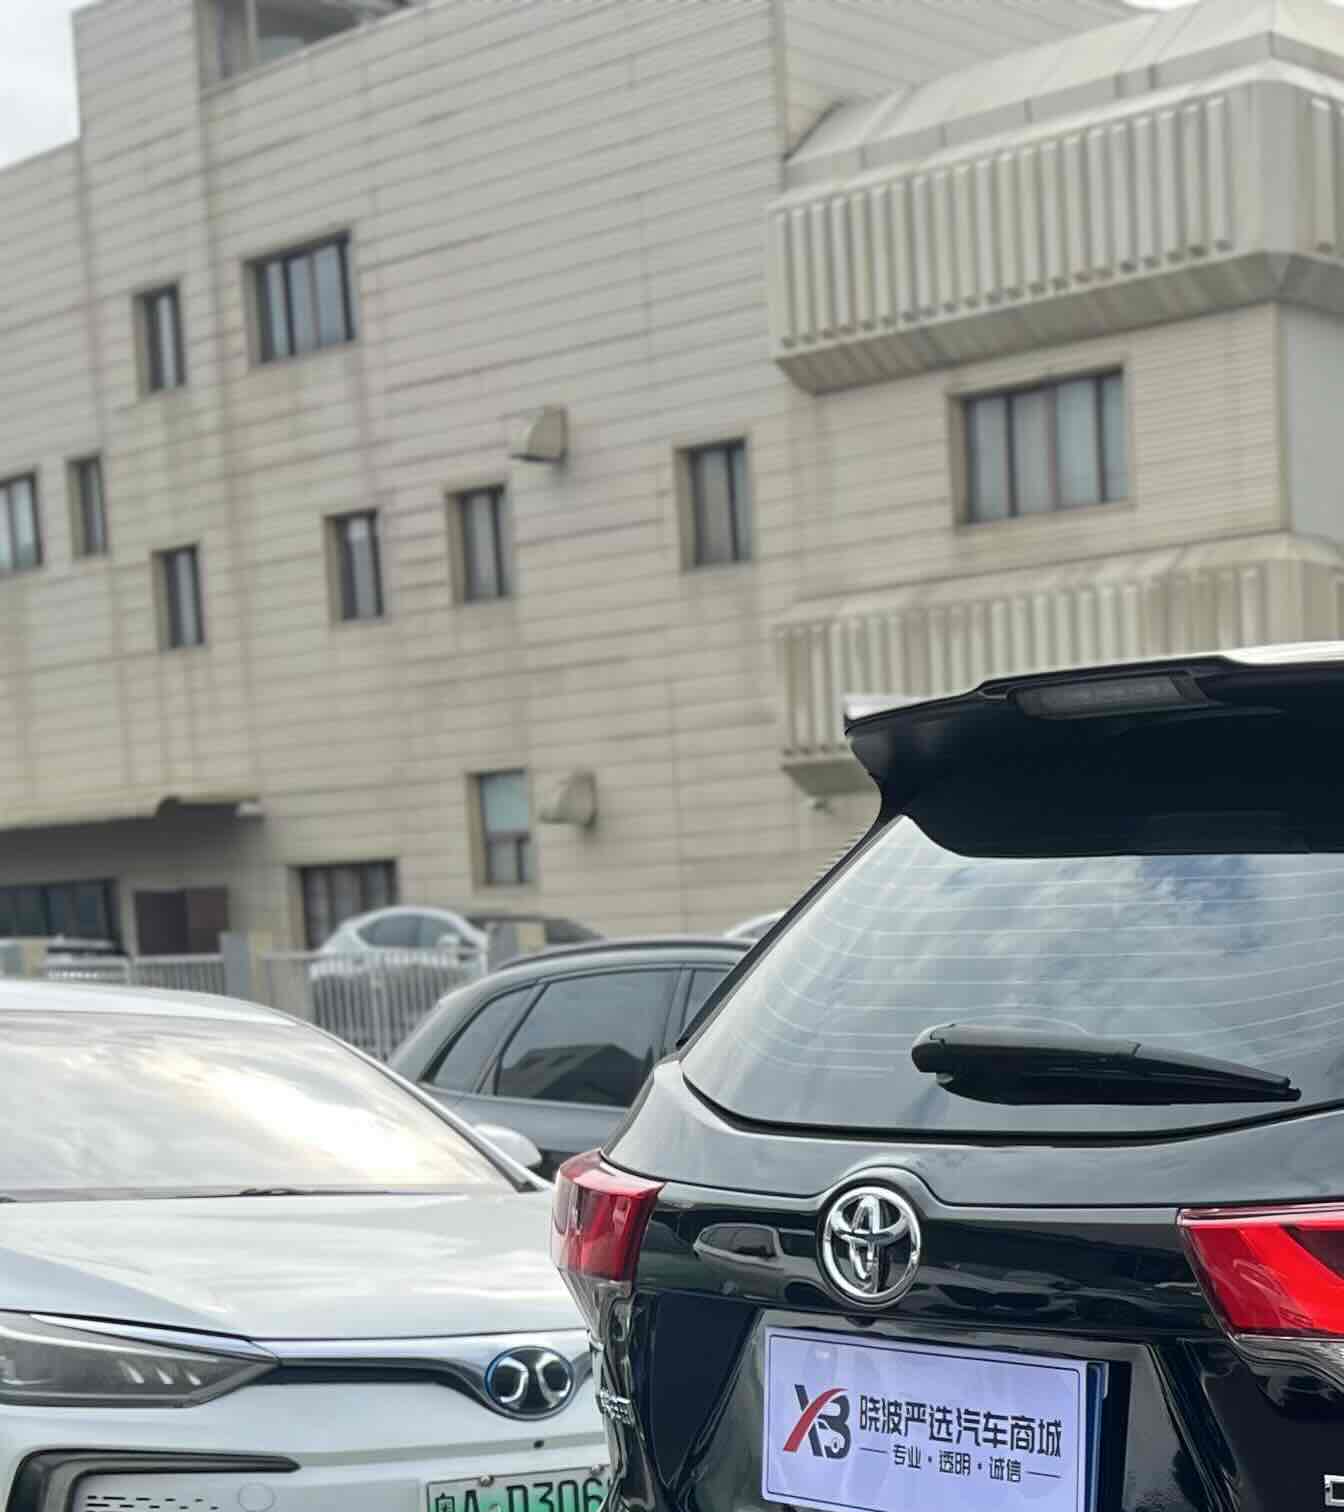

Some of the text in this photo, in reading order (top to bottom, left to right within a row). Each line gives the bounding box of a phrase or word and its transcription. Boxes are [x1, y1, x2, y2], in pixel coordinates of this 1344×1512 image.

[859, 1394, 1063, 1459] 晓波严选汽车商城
